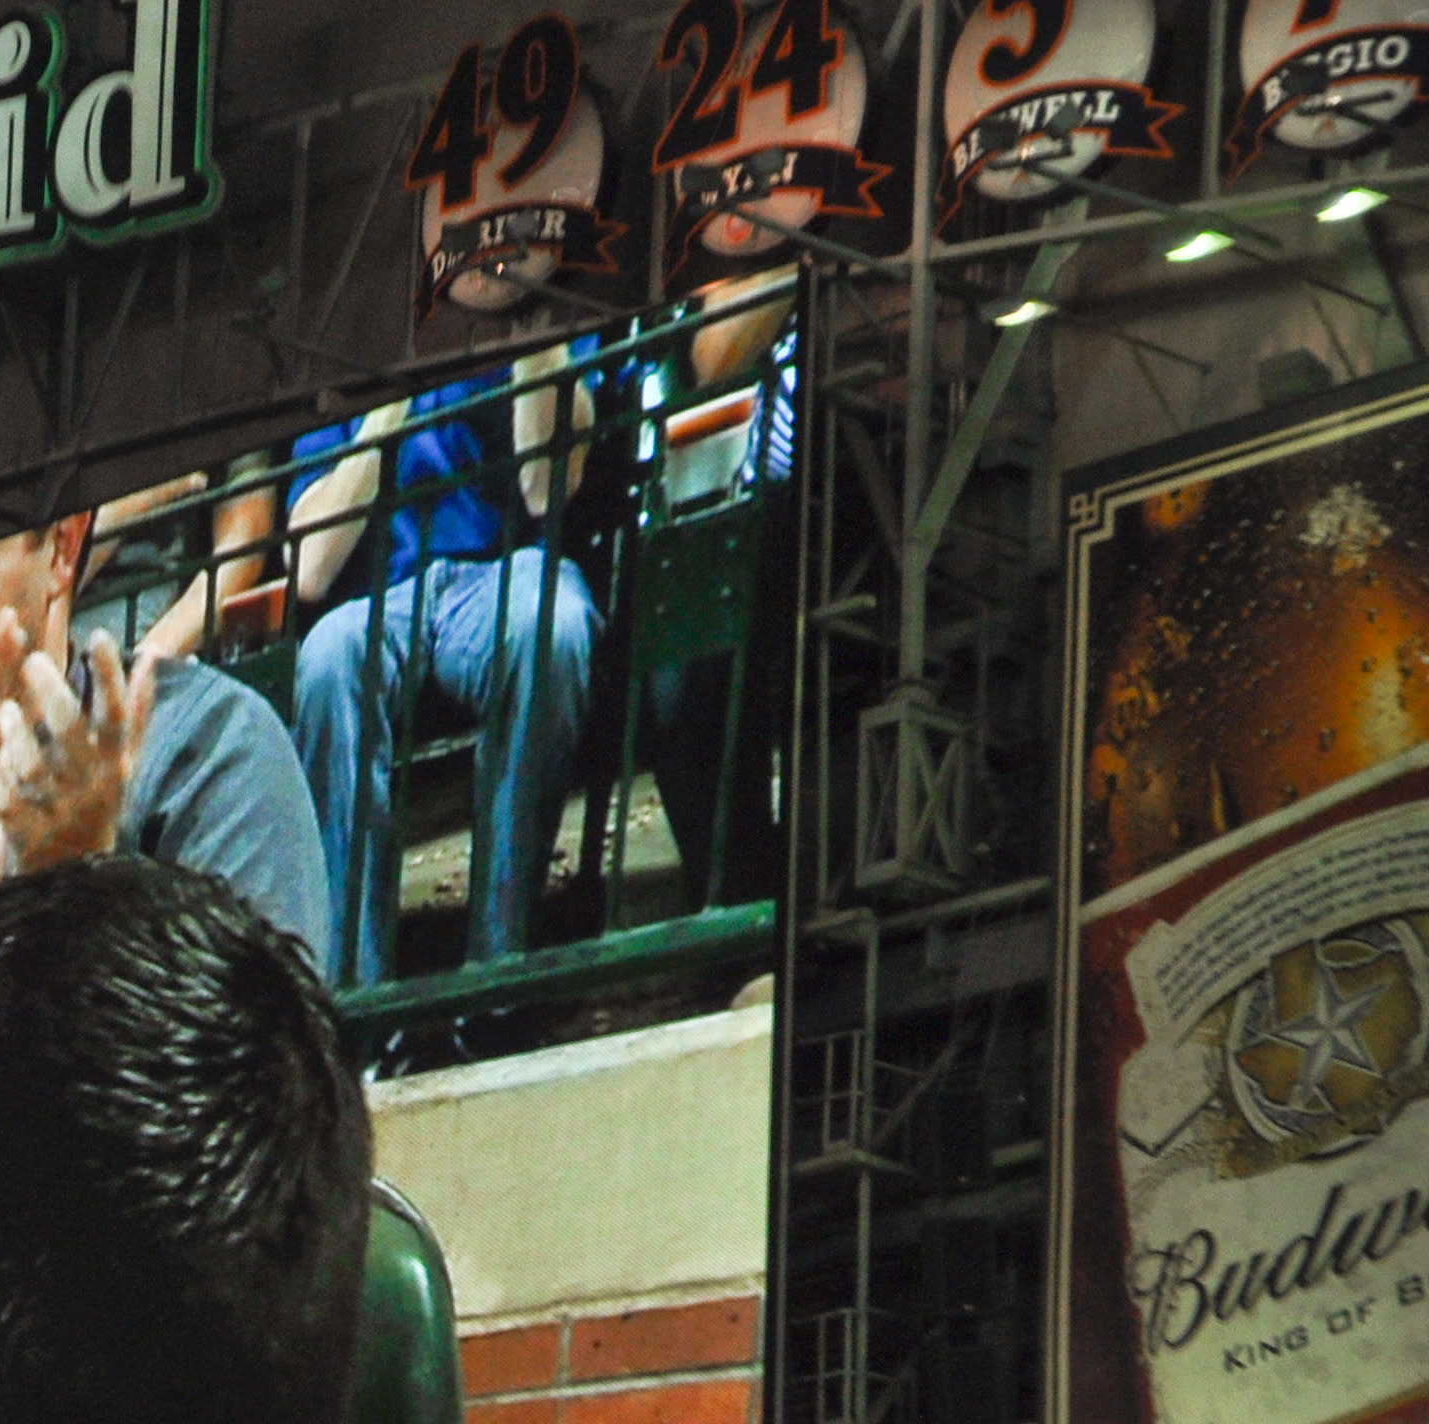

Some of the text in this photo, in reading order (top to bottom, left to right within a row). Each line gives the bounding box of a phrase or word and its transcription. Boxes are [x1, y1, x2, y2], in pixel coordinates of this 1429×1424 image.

[405, 11, 581, 215] 49
[652, 0, 844, 174] 24
[1125, 1183, 1429, 1357] Budw
[1224, 1325, 1309, 1374] KING
[1326, 1296, 1378, 1336] OF
